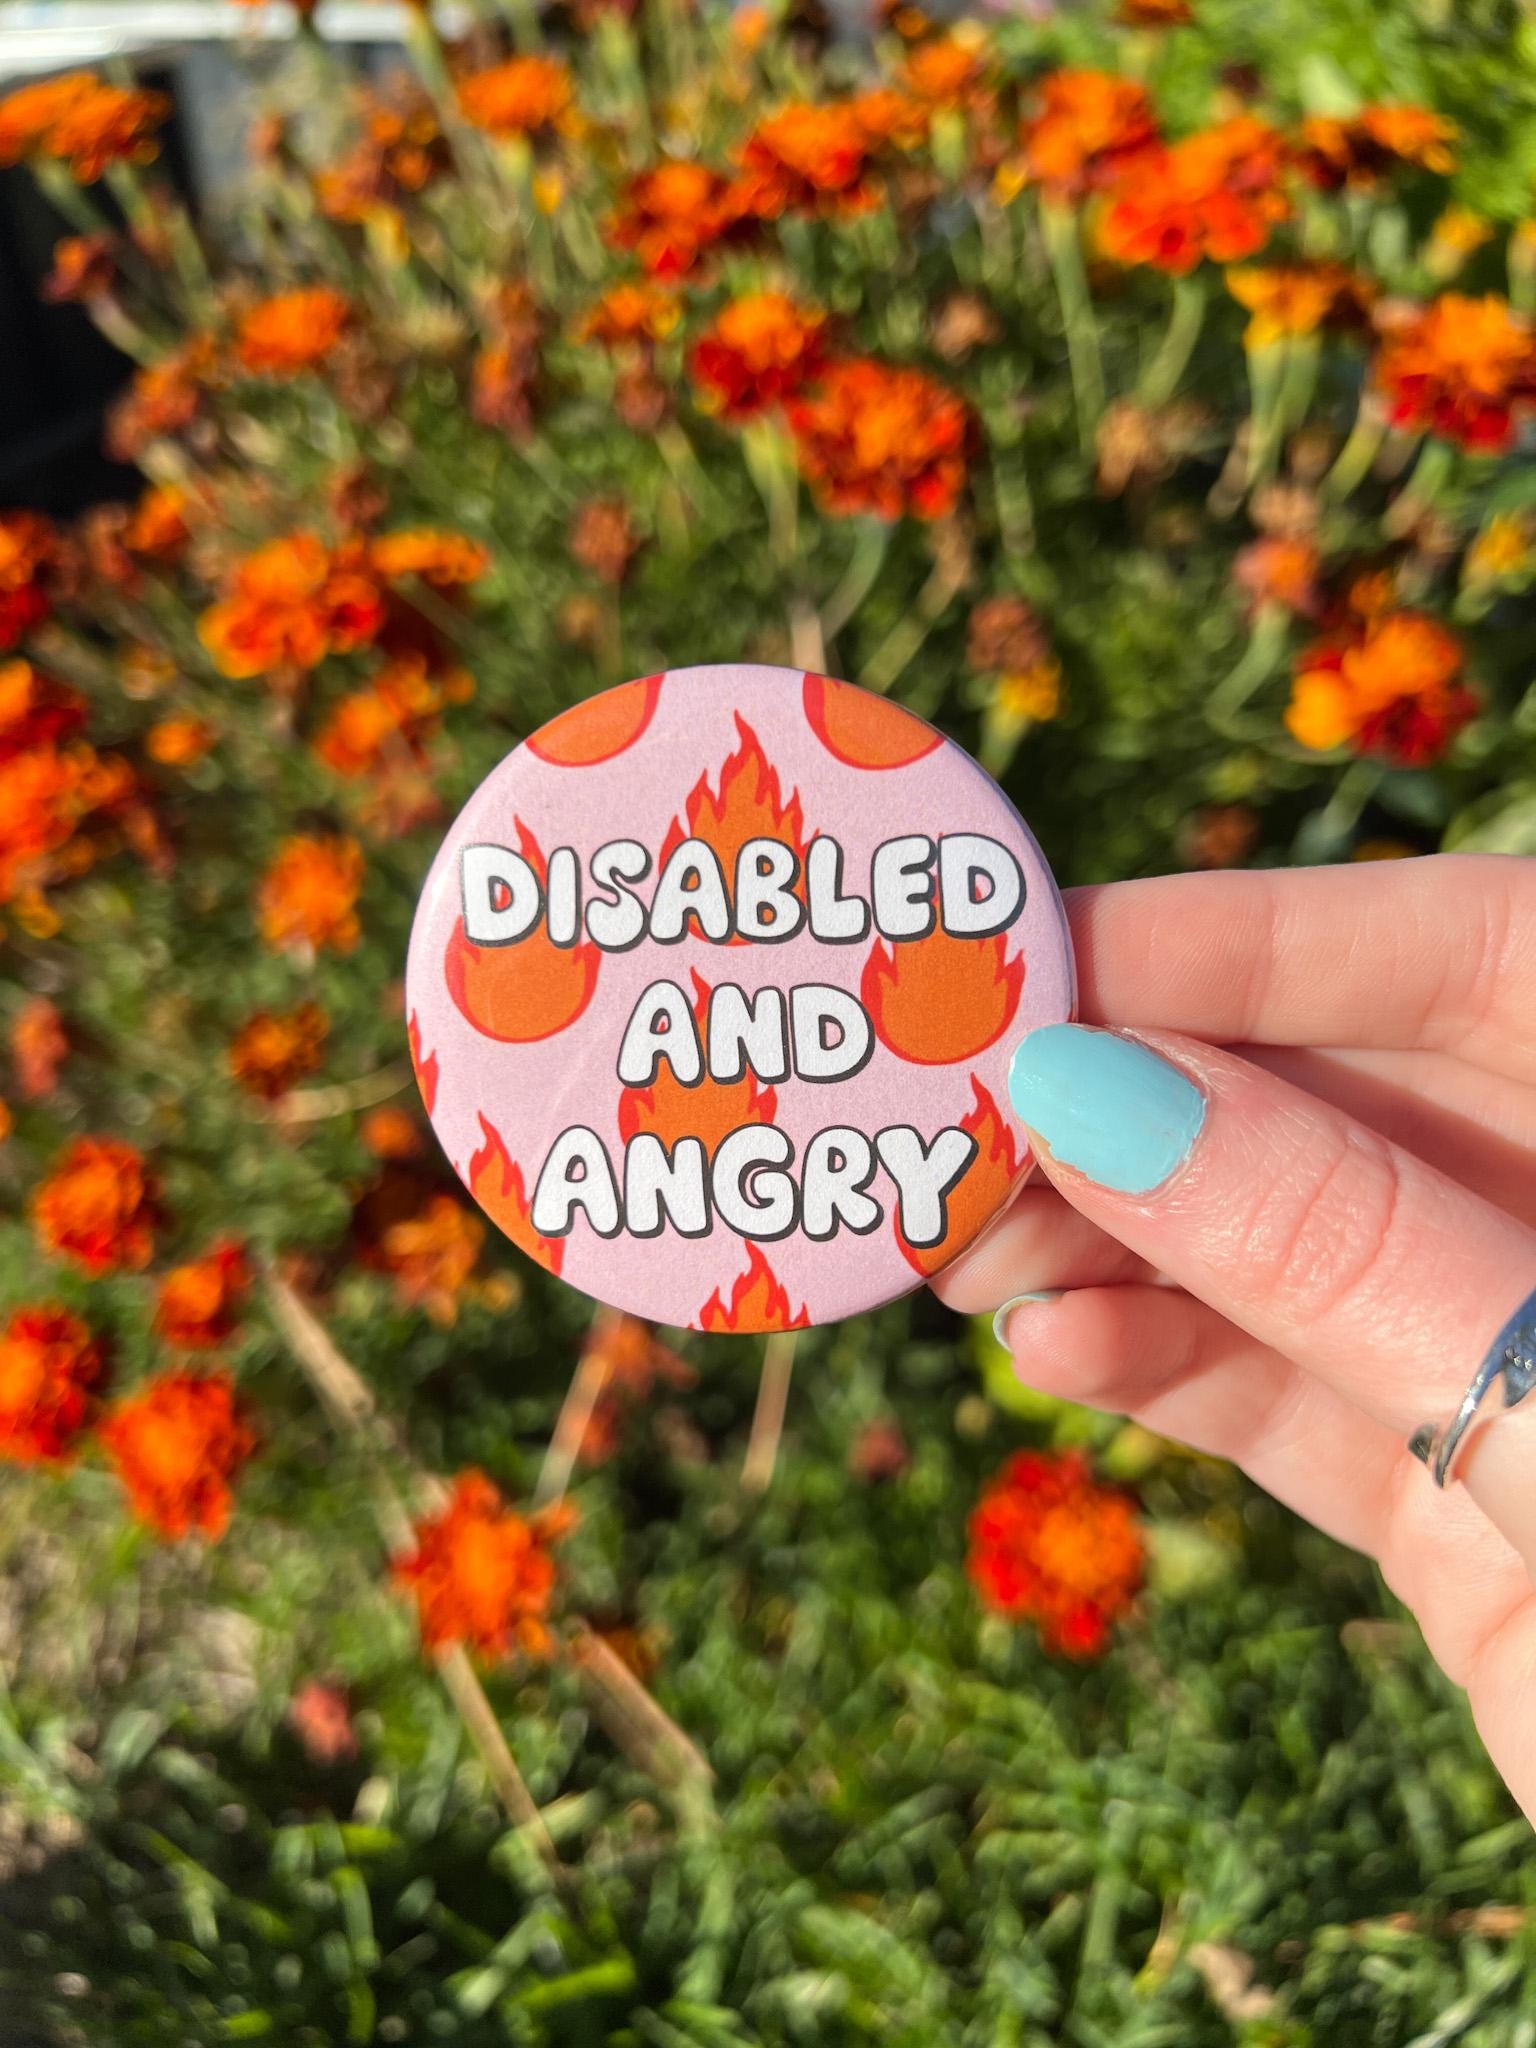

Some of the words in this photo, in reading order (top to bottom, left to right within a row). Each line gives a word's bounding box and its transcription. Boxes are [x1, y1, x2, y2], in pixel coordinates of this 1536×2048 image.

[461, 833, 1026, 951] DISABLED
[617, 980, 874, 1088] AND
[532, 1124, 977, 1249] ANGRY
